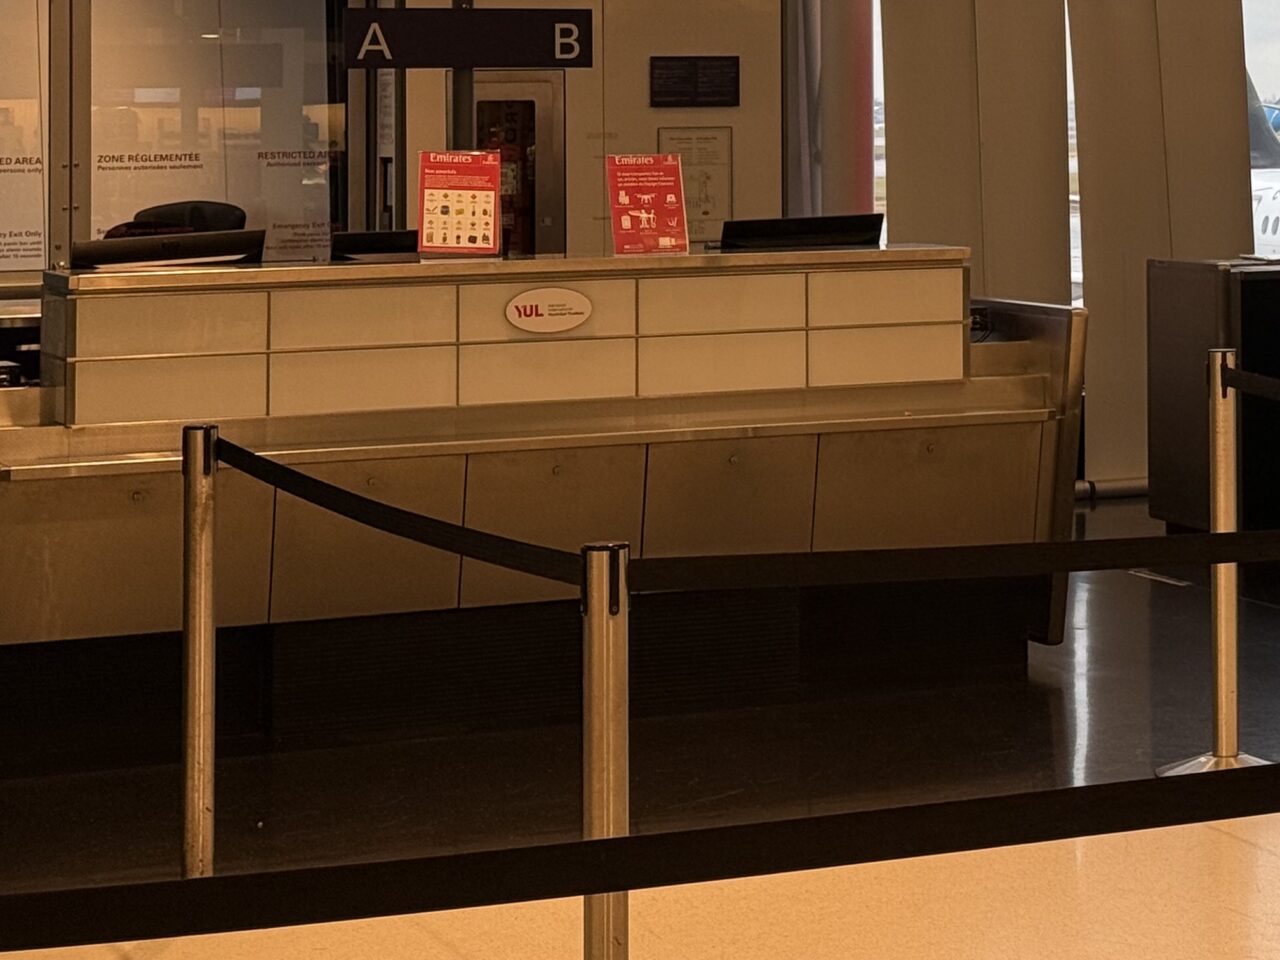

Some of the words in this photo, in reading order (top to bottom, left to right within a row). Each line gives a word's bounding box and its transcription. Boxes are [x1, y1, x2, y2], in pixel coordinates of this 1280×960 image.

[357, 22, 393, 60] A
[554, 23, 581, 60] B
[14, 156, 42, 165] AREA
[97, 154, 125, 163] ZONE
[127, 152, 200, 162] RÉGLEMENTÉE
[257, 151, 315, 160] RESTRICTED
[430, 153, 473, 163] Emirates
[615, 156, 654, 165] Emirates
[514, 304, 544, 319] YUL
